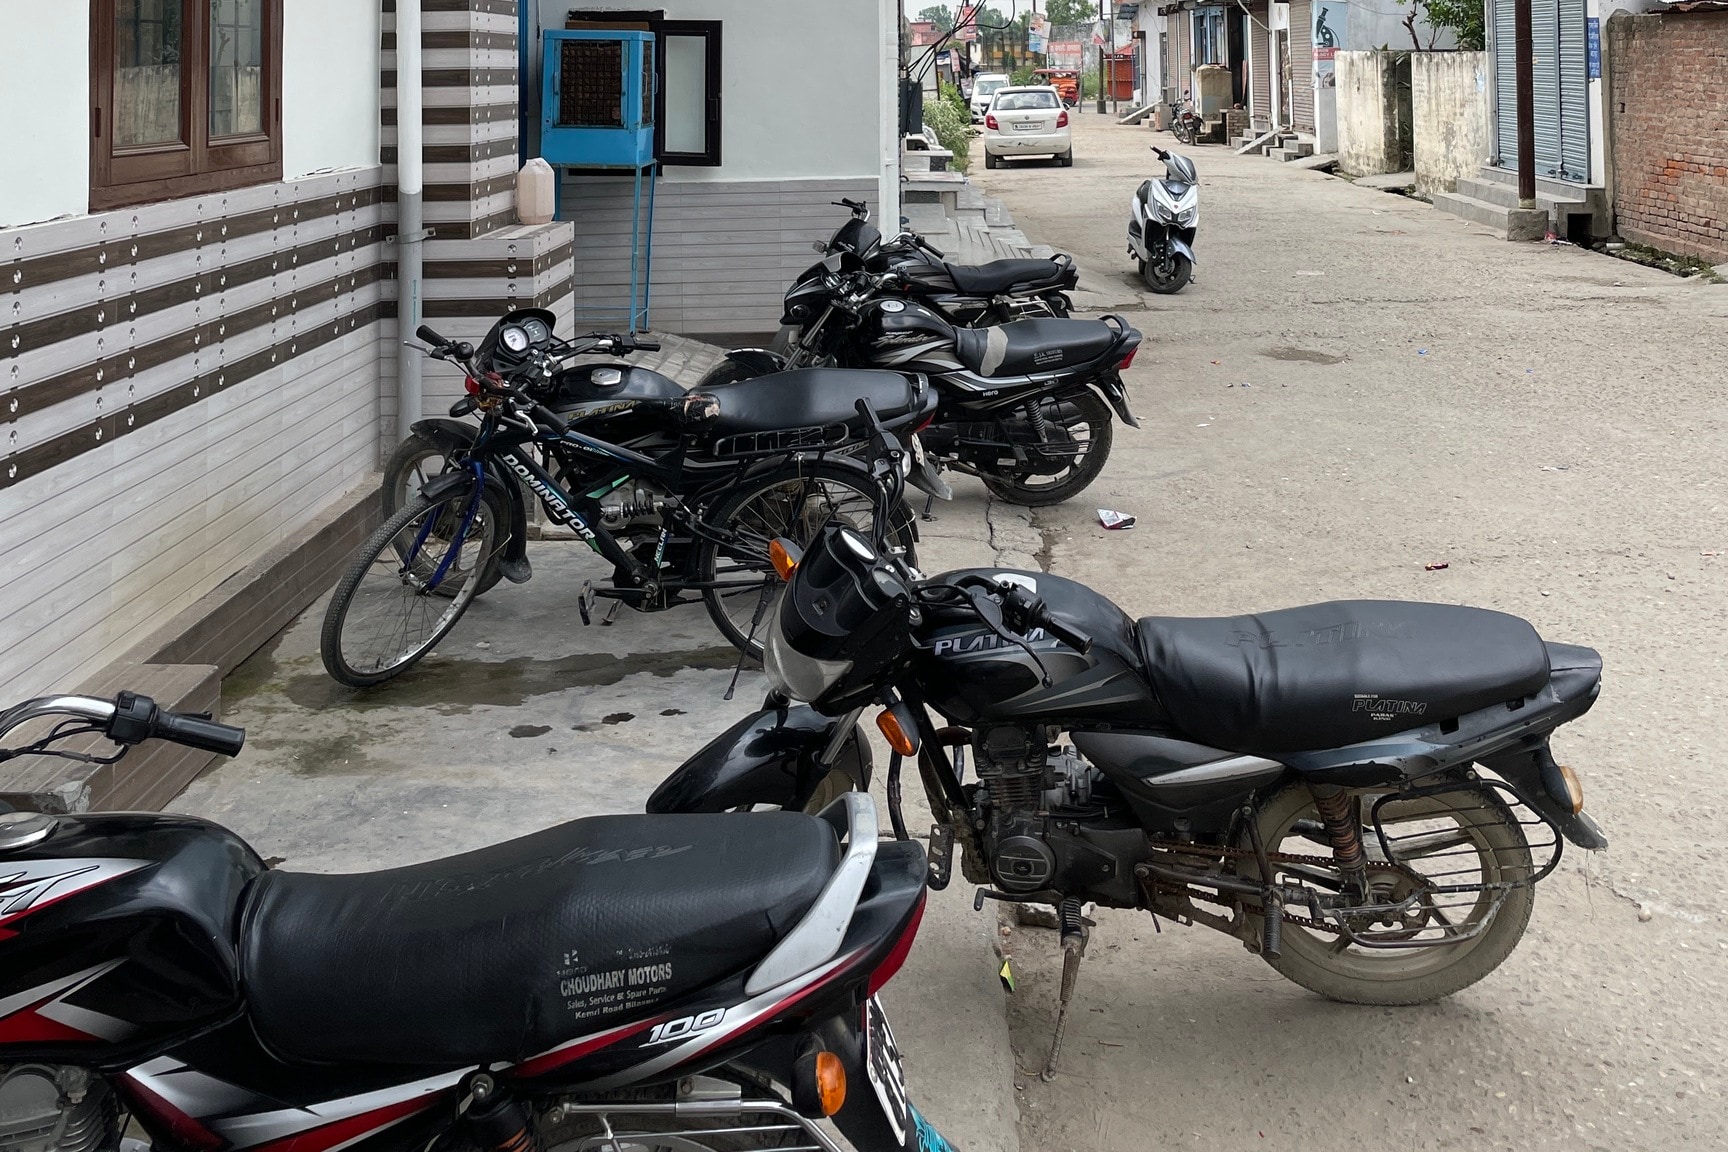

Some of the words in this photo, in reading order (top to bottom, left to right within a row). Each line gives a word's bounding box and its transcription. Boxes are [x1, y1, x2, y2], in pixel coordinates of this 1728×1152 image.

[567, 400, 638, 421] PLATINA
[502, 453, 596, 540] DOMINATOR
[1351, 699, 1427, 714] PLATINA
[560, 969, 624, 997] CHOUDHARY
[628, 962, 672, 986] MOTORS
[589, 993, 615, 1006] Service
[616, 991, 624, 1001] &
[626, 988, 647, 1000] Spare
[602, 1003, 623, 1014] Road
[650, 1008, 726, 1043] 100
